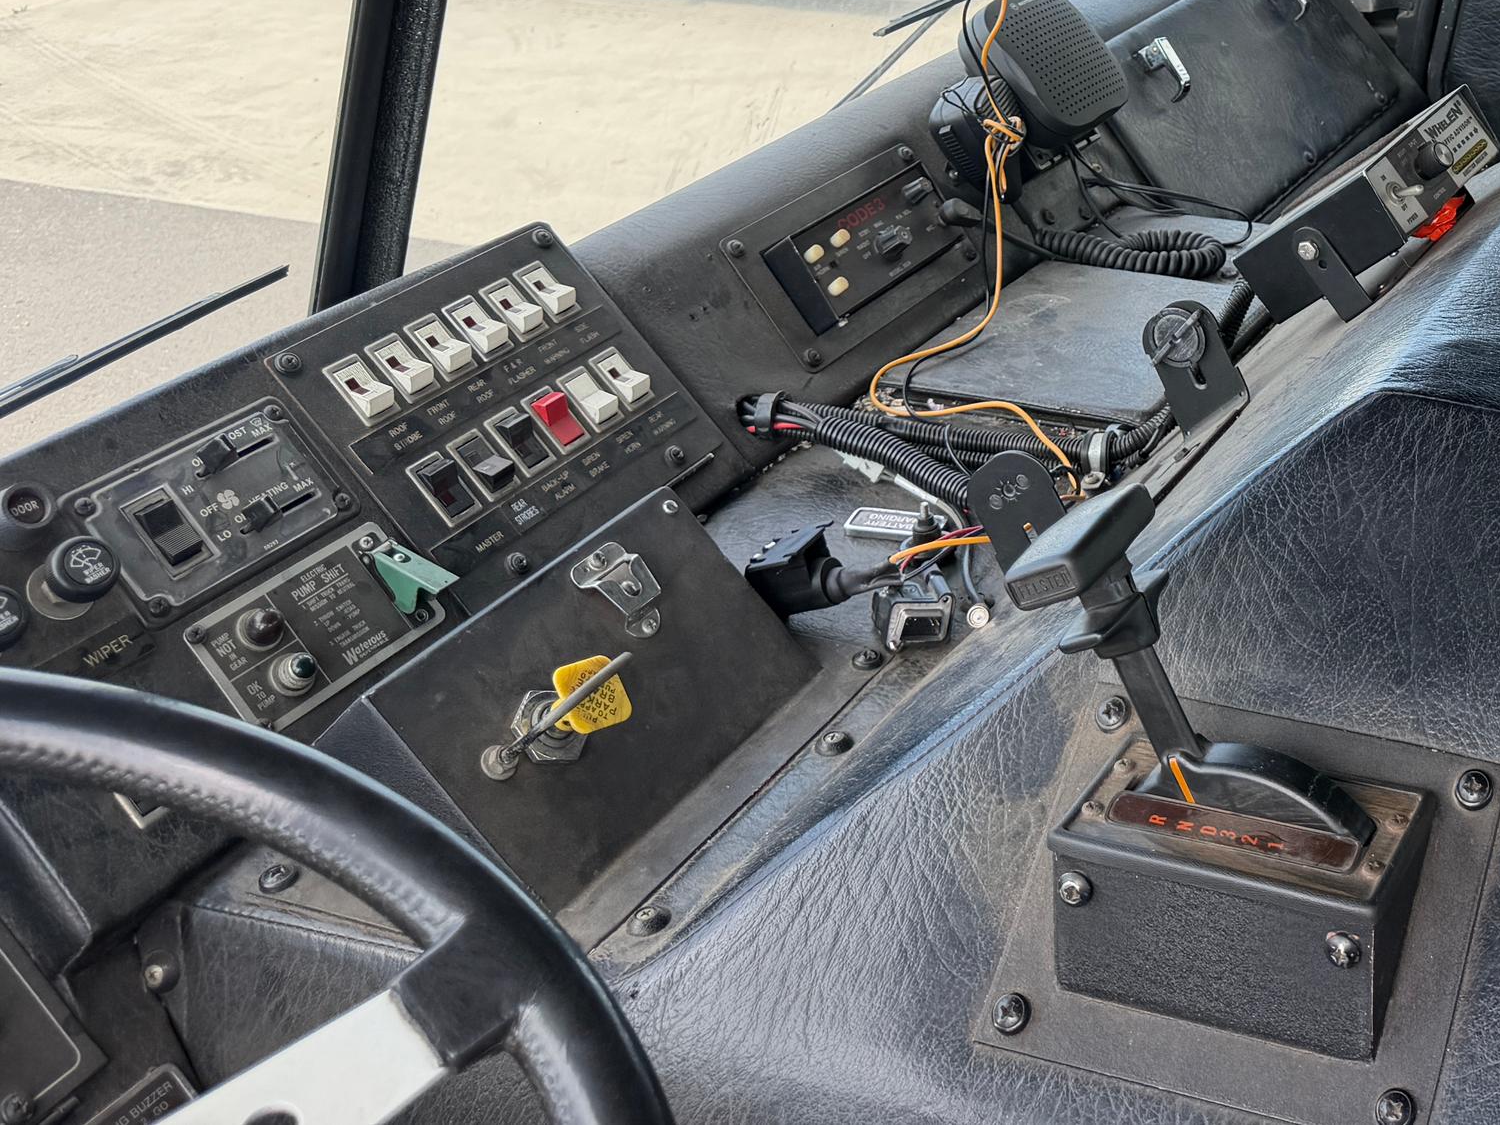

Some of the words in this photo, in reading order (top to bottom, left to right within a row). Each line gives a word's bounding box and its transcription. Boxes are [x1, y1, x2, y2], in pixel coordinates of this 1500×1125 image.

[508, 366, 537, 385] FLASHER
[468, 378, 487, 393] REAR
[476, 389, 495, 404] ROOF
[427, 399, 450, 417] FRONT
[438, 410, 457, 426] ROOF
[251, 424, 274, 439] MAX
[388, 422, 409, 438] ROOF
[393, 430, 424, 452] STROBE
[181, 484, 195, 496] HI
[292, 477, 314, 492] MAX
[10, 500, 39, 517] DOOR
[199, 502, 219, 518] OFF
[511, 499, 527, 513] REAR
[514, 506, 540, 526] STROBES
[218, 529, 232, 542] LO
[475, 530, 505, 554] MASTER
[301, 564, 326, 582] ELECTRIC
[291, 581, 317, 602] PUMP
[321, 564, 346, 584] SHIFT
[211, 633, 230, 647] PUMP
[342, 630, 387, 666] Waterous
[82, 634, 133, 668] WIPER
[217, 640, 236, 657] NOT
[230, 657, 248, 671] GEAR
[246, 681, 262, 695] OK
[257, 691, 266, 699] TO
[257, 695, 277, 710] PUMP
[598, 710, 608, 720] TO
[1149, 814, 1168, 826] R
[1176, 821, 1195, 832] N
[1200, 826, 1218, 837] D
[1219, 830, 1237, 841] 3
[1240, 835, 1259, 846] 2
[1267, 841, 1285, 852] 1
[130, 1081, 173, 1119] BUZZER
[153, 1101, 169, 1116] GO
